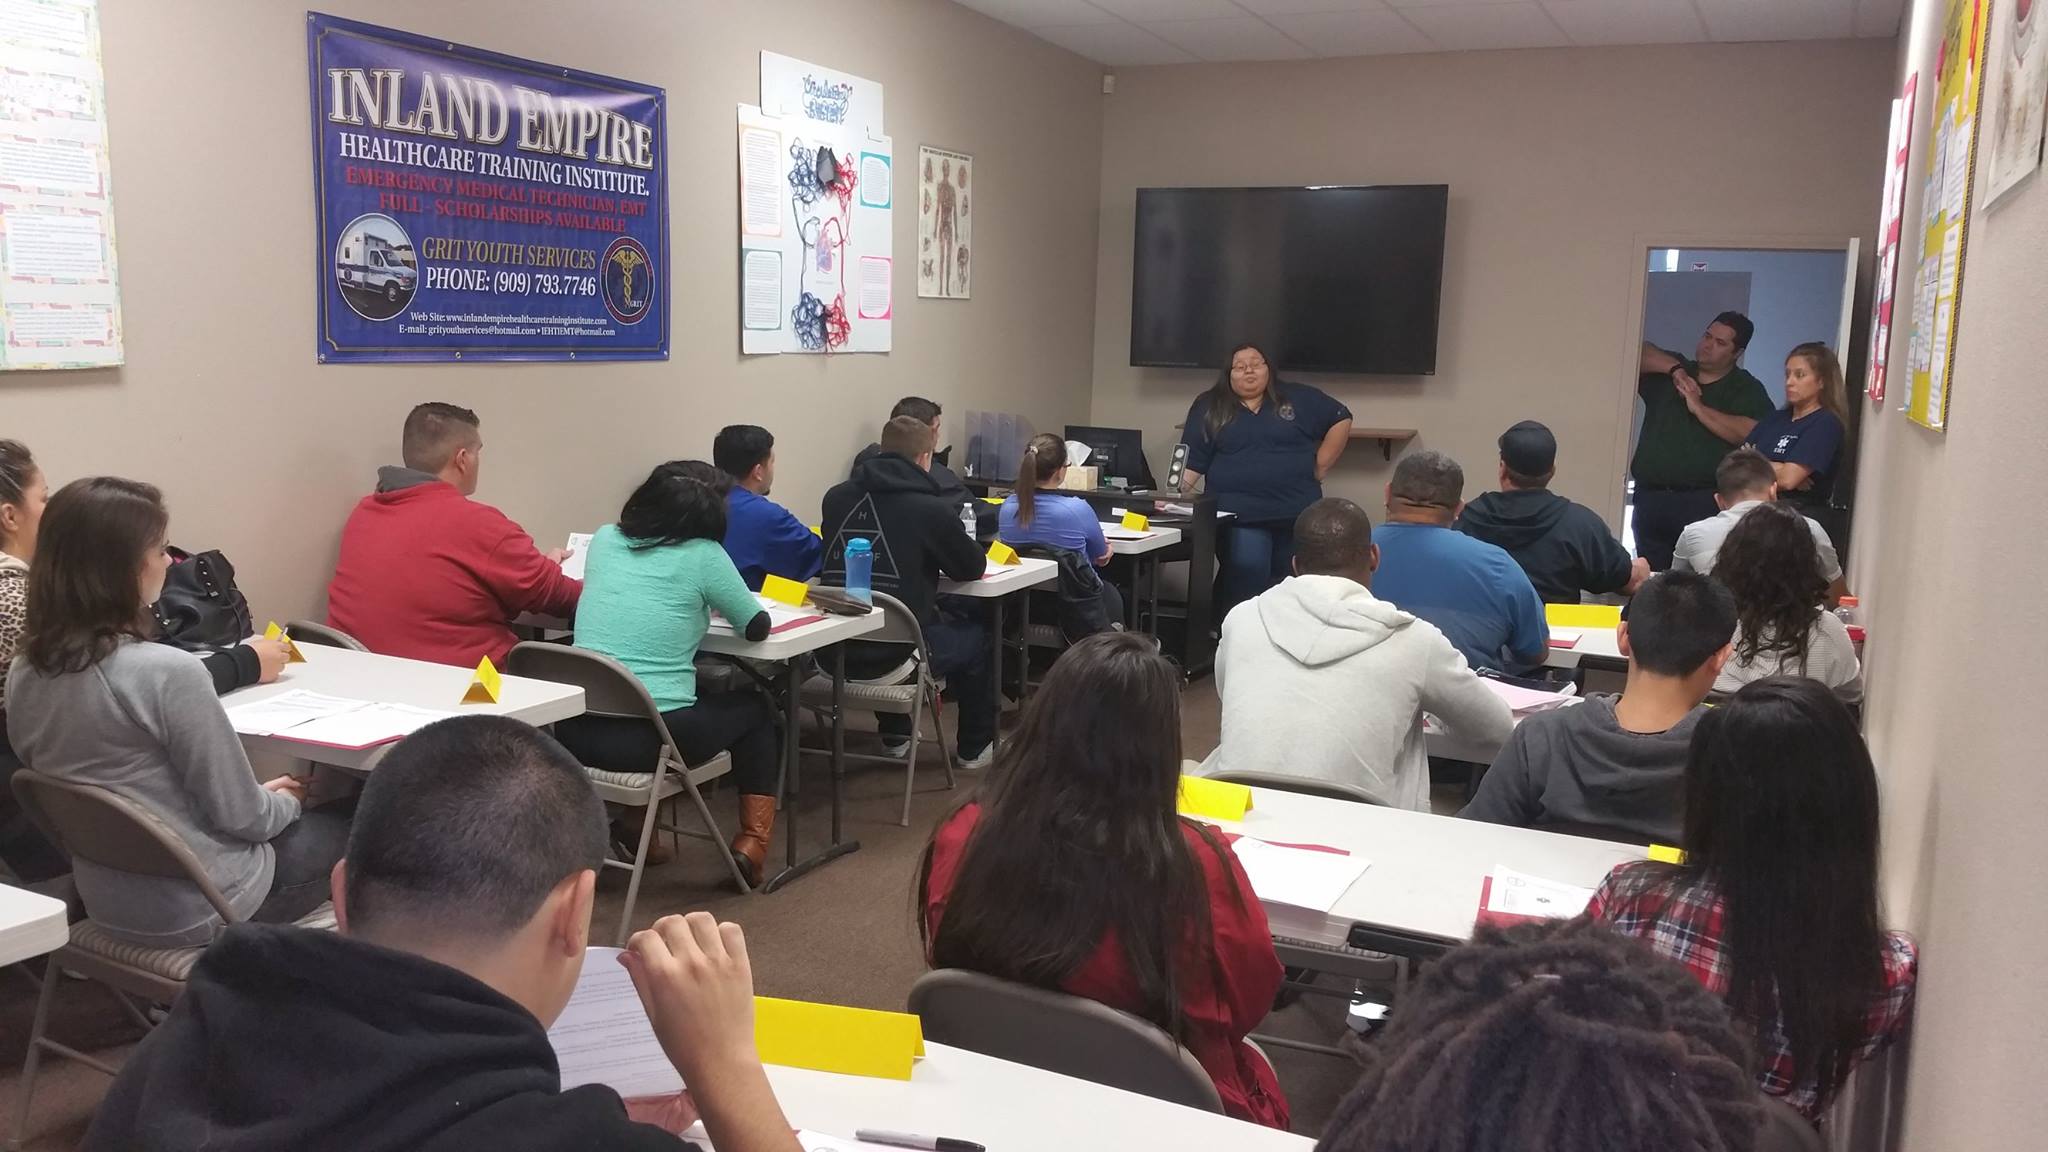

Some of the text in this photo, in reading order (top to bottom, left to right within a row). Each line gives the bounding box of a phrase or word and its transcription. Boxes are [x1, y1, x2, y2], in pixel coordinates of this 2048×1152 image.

[328, 68, 653, 170] INLAND EMPIRE
[339, 132, 649, 196] HEALTHCARE TRAINING INSTITUTE.
[346, 166, 453, 194] EMERGENCY
[457, 178, 526, 202] MEDICAL
[620, 200, 647, 216] EMT
[379, 192, 422, 213] FULL
[435, 200, 552, 225] SCHOLARSHIPS
[554, 212, 626, 233] AVAILABLE
[422, 237, 596, 270] GRIT YOUTH SERVICES
[426, 267, 596, 296] PHONE: (909) 793.7746
[399, 324, 427, 334] E-mail:
[428, 325, 536, 336] grityouthservices@hotmail.com
[411, 312, 428, 321] Web
[857, 511, 867, 520] H
[833, 551, 840, 560] U
